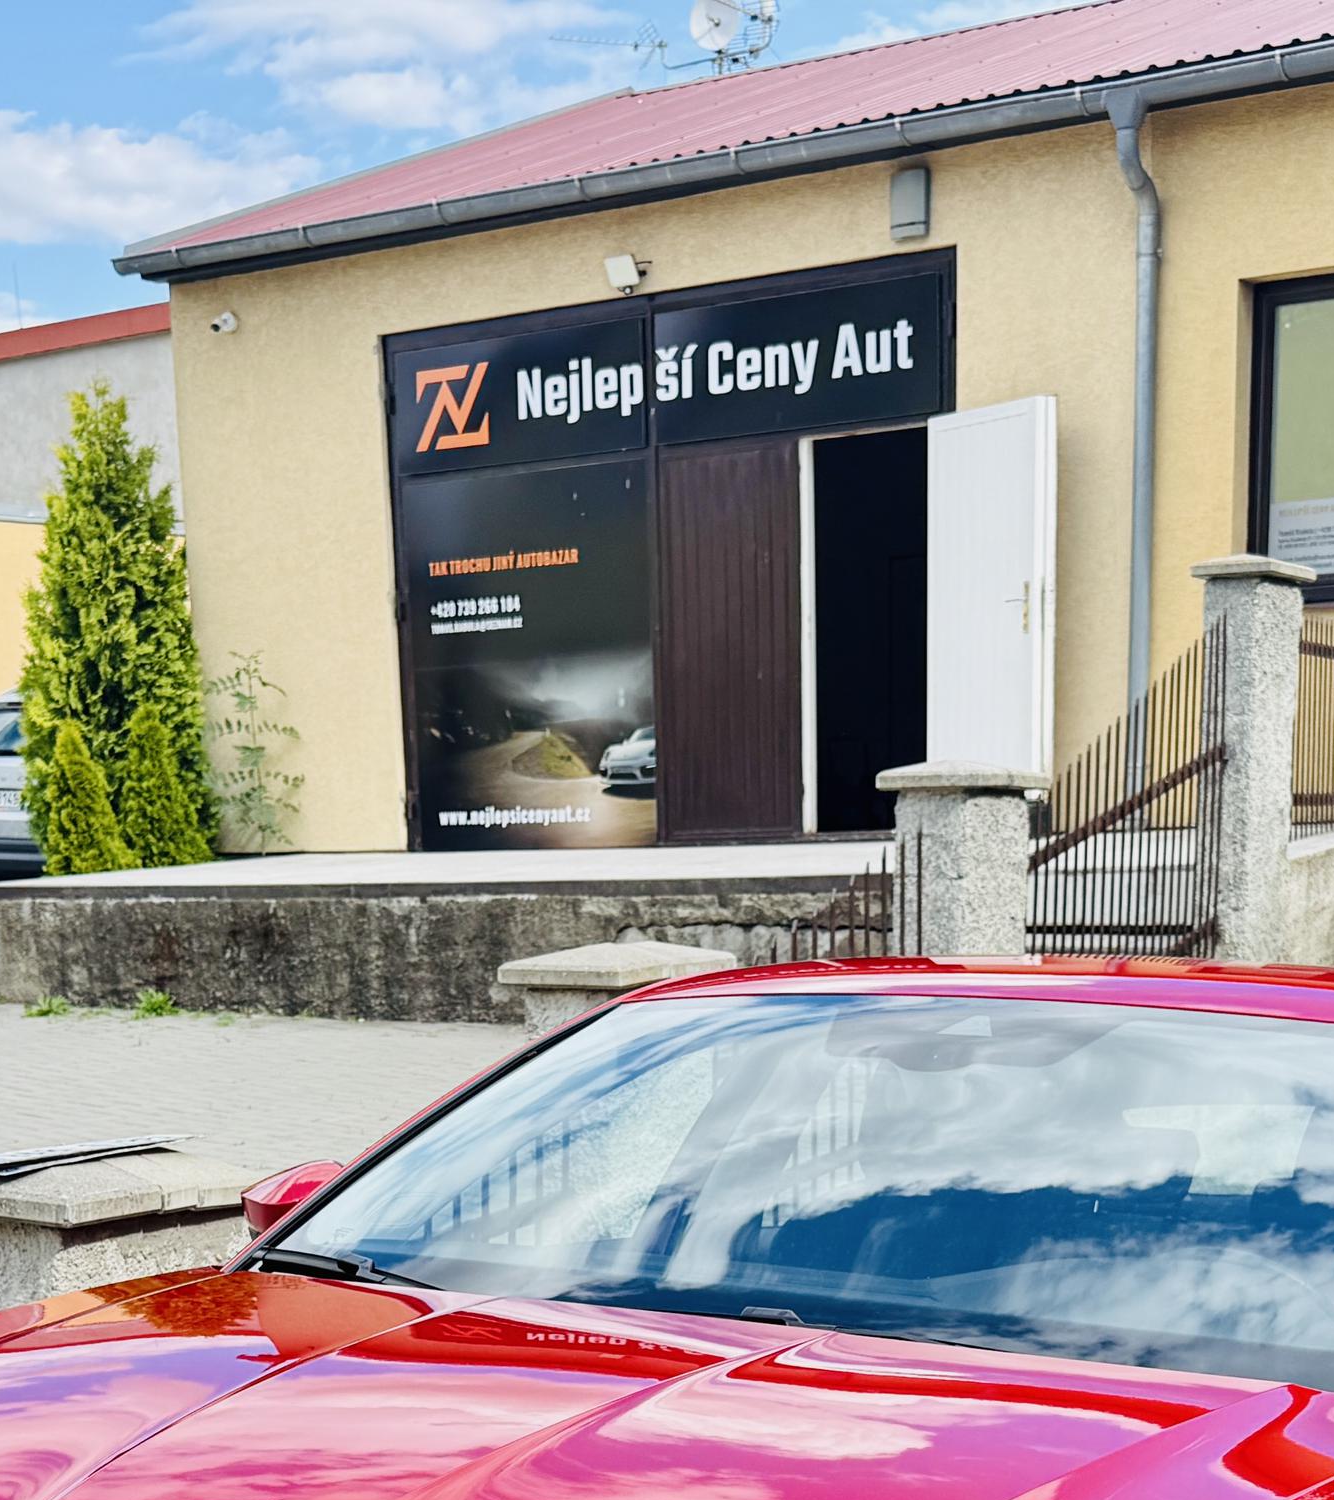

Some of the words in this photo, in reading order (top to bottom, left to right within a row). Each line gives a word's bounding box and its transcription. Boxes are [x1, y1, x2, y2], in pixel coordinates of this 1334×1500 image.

[707, 339, 819, 395] Ceny
[831, 318, 914, 380] Aut
[428, 561, 449, 577] TAK
[449, 556, 491, 575] TROCHU
[516, 547, 579, 569] AUTOBAZAR
[438, 804, 591, 828] www.nejlepsicenyaut.cz
